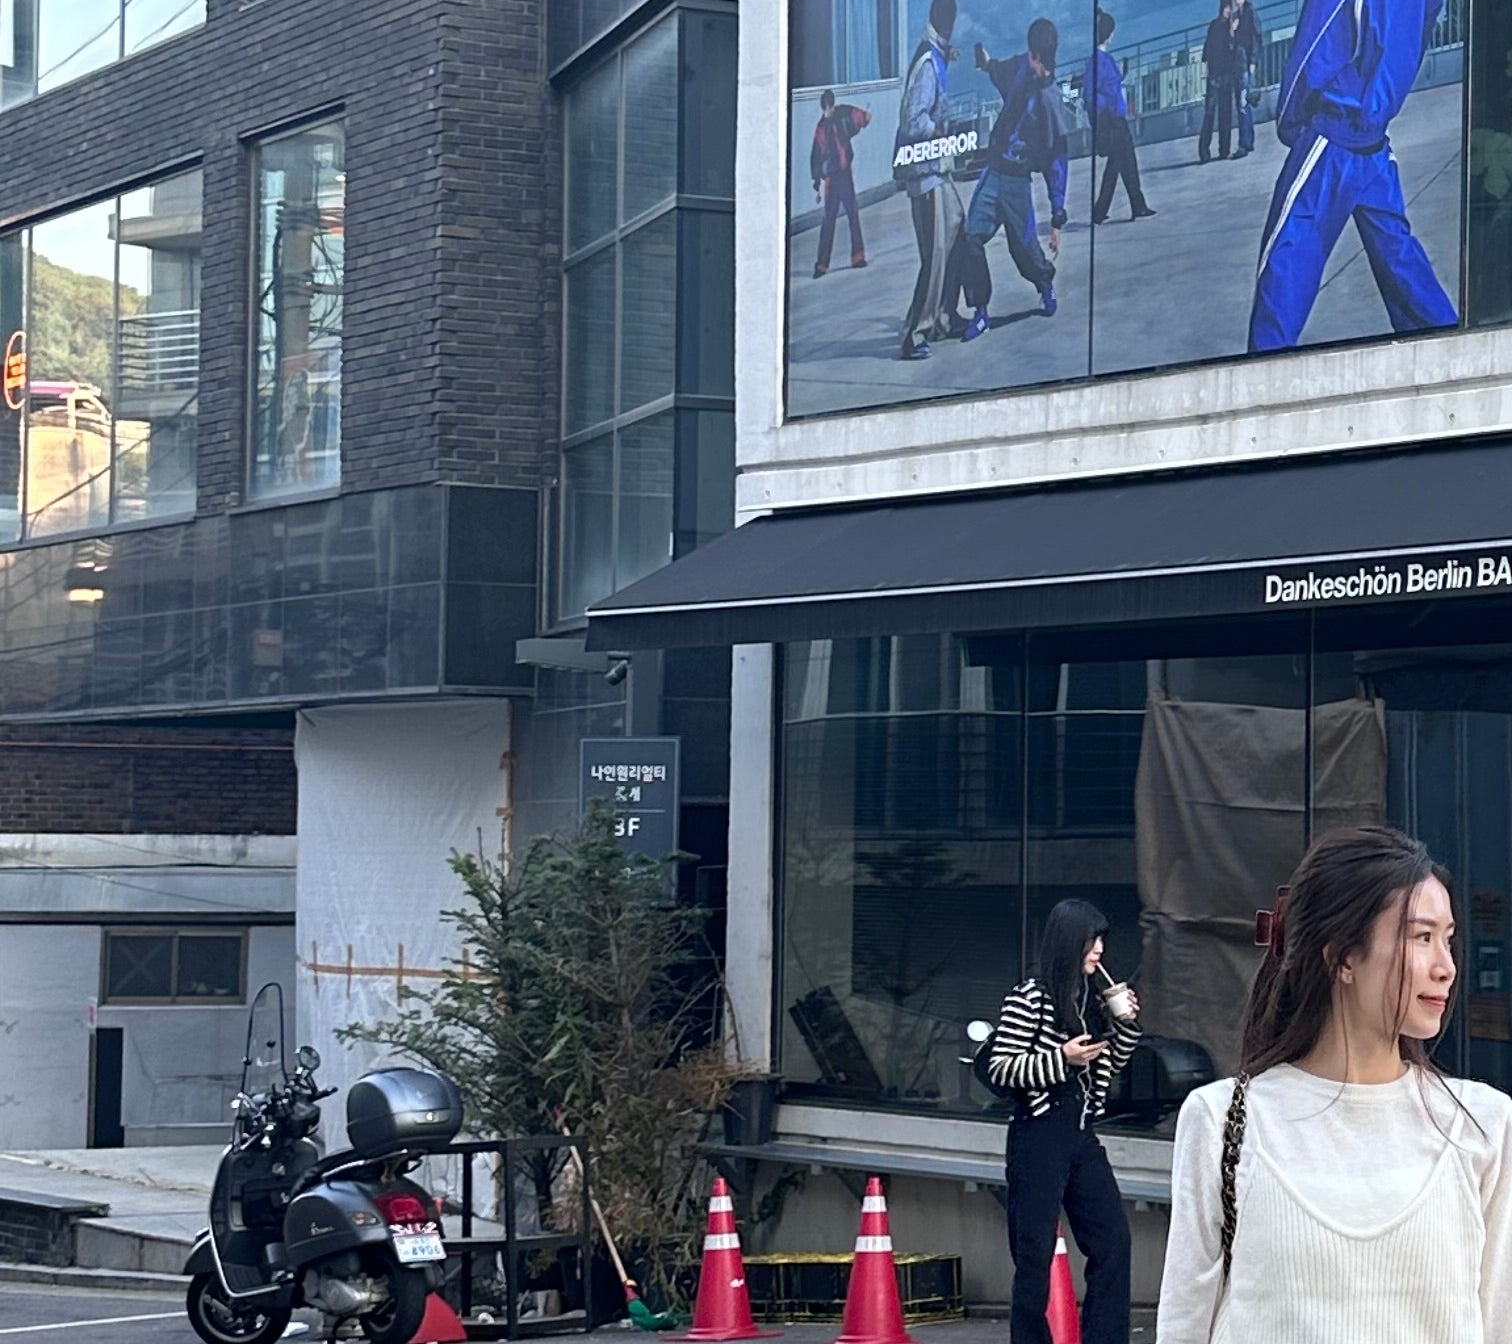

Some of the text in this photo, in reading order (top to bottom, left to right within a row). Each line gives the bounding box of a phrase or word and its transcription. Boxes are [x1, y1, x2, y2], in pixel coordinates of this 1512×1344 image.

[893, 131, 978, 167] ADERERROR
[1265, 567, 1401, 604] Dankeschön
[1407, 559, 1472, 593] Berlin
